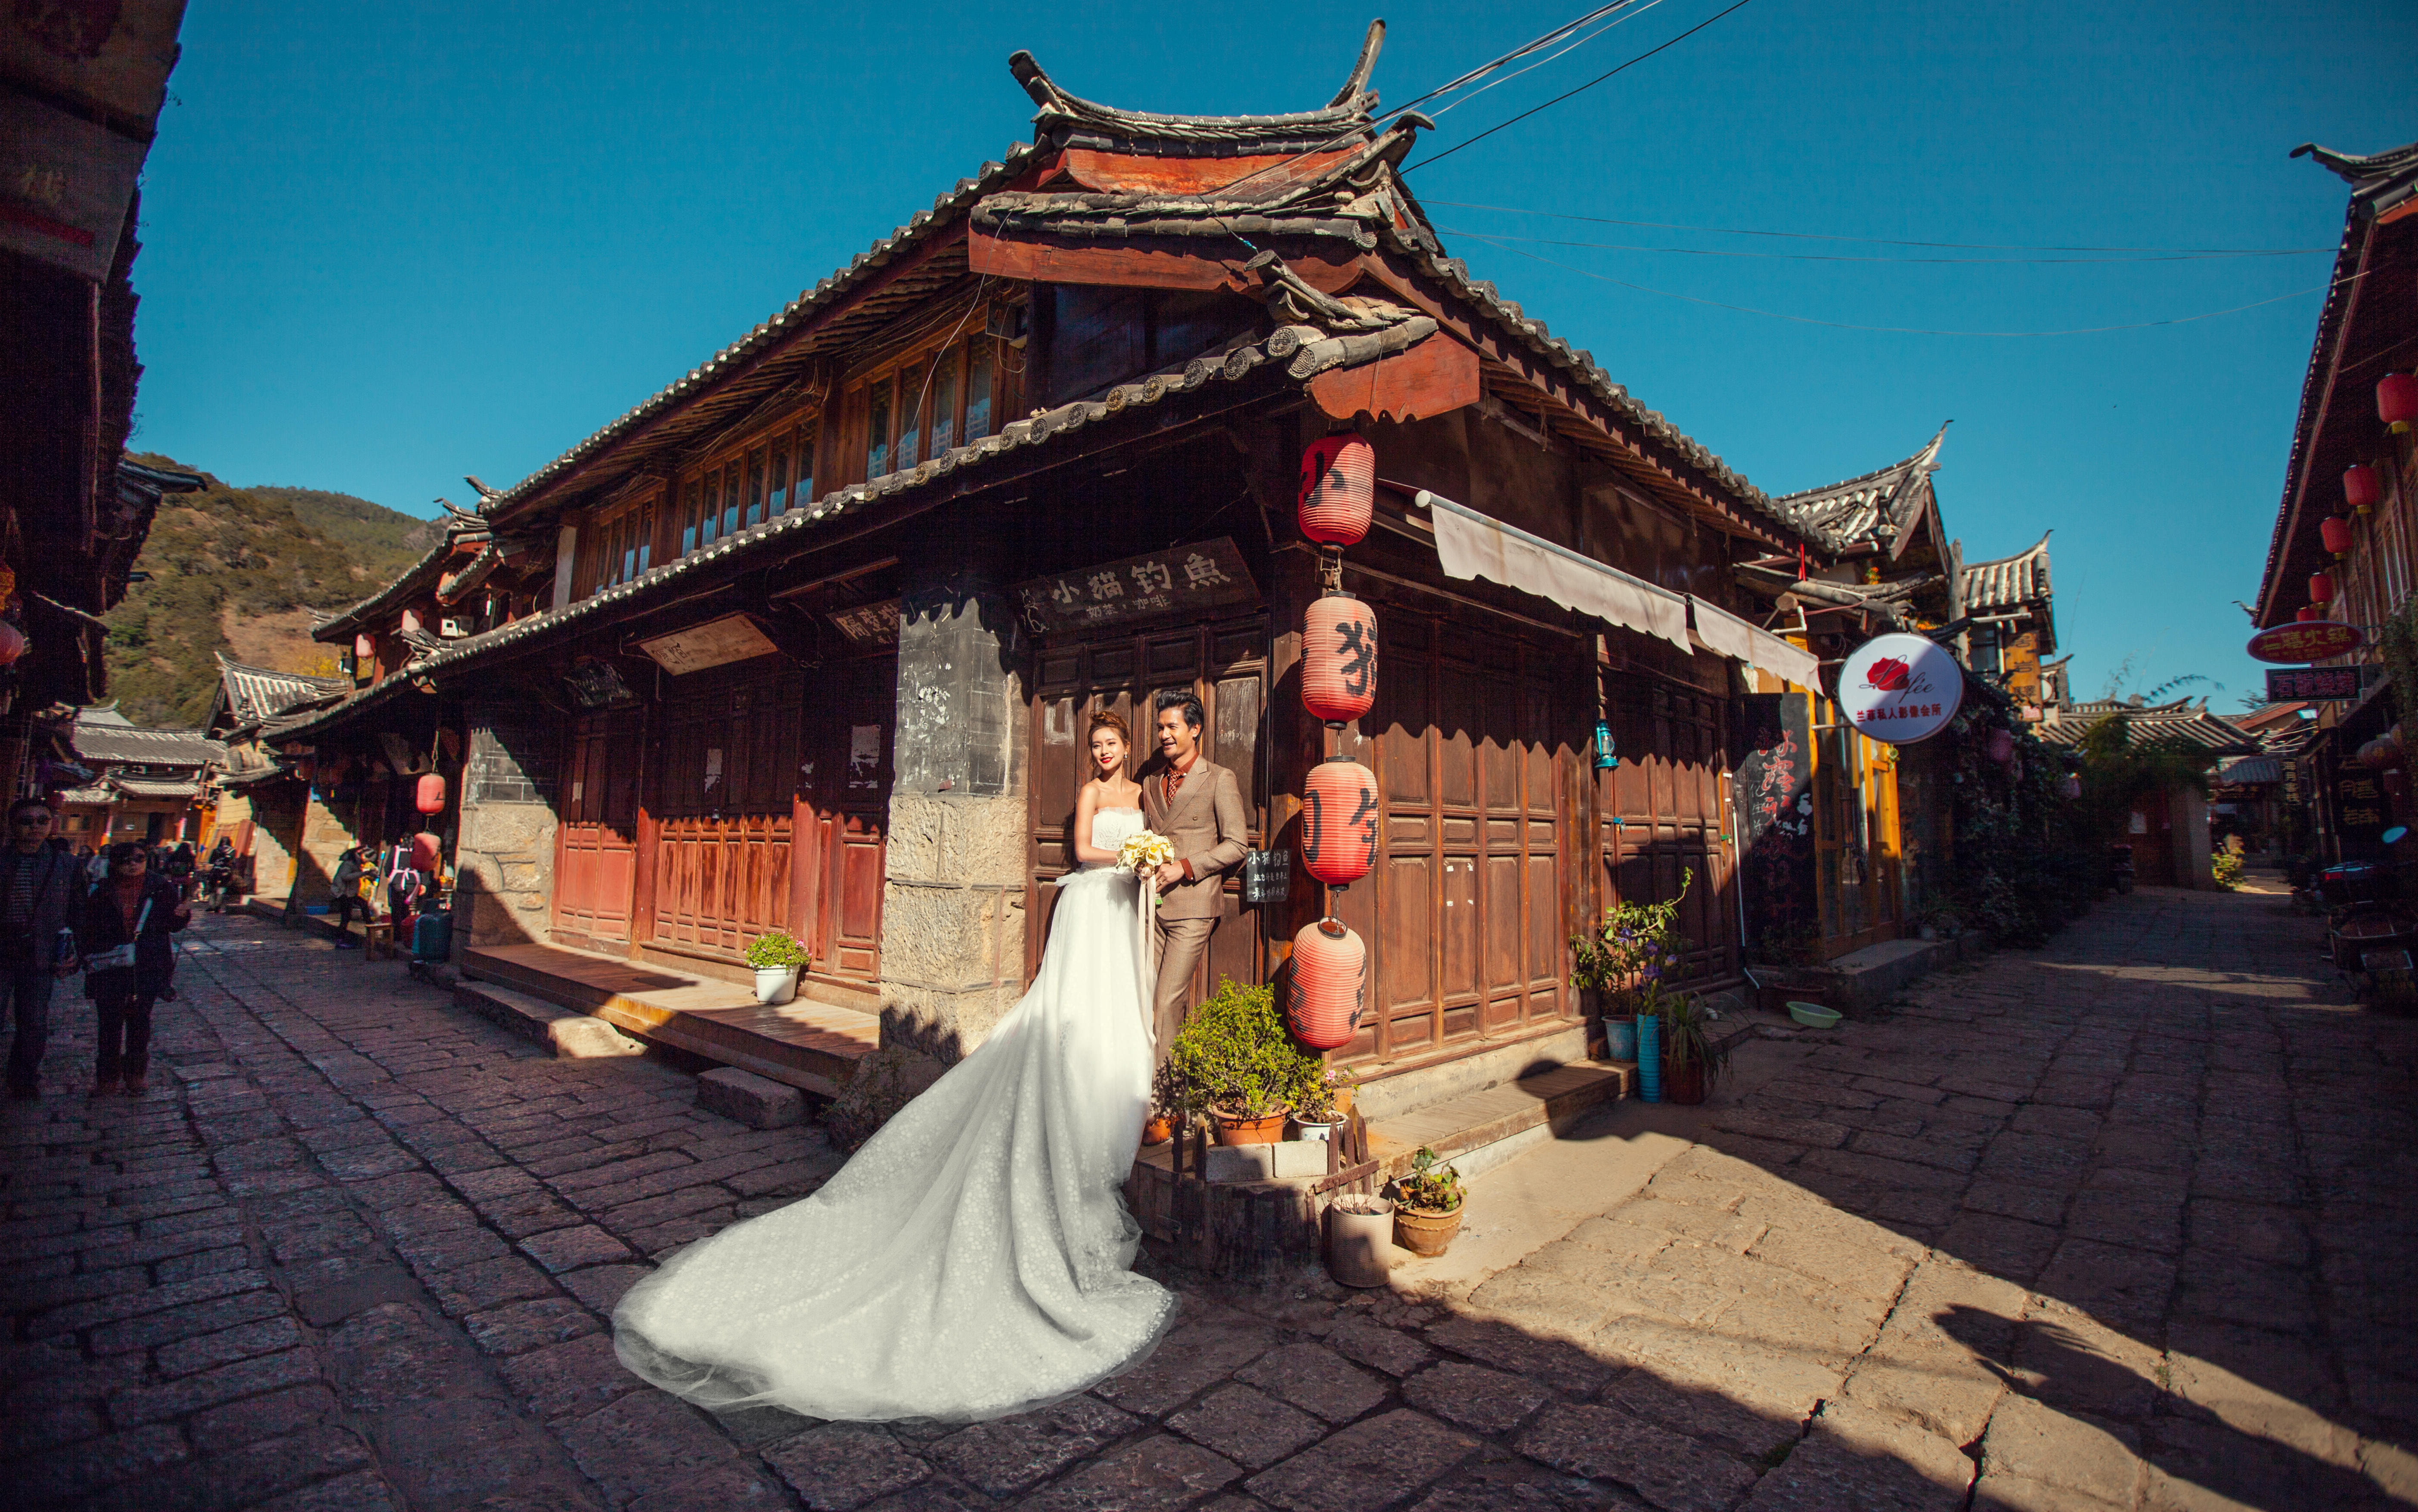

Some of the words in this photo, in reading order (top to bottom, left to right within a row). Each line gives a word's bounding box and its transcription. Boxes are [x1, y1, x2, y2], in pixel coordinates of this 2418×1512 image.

[1857, 703, 1941, 722] 兰菲私人影像会所
[1248, 850, 1289, 867] 小猫钓鱼
